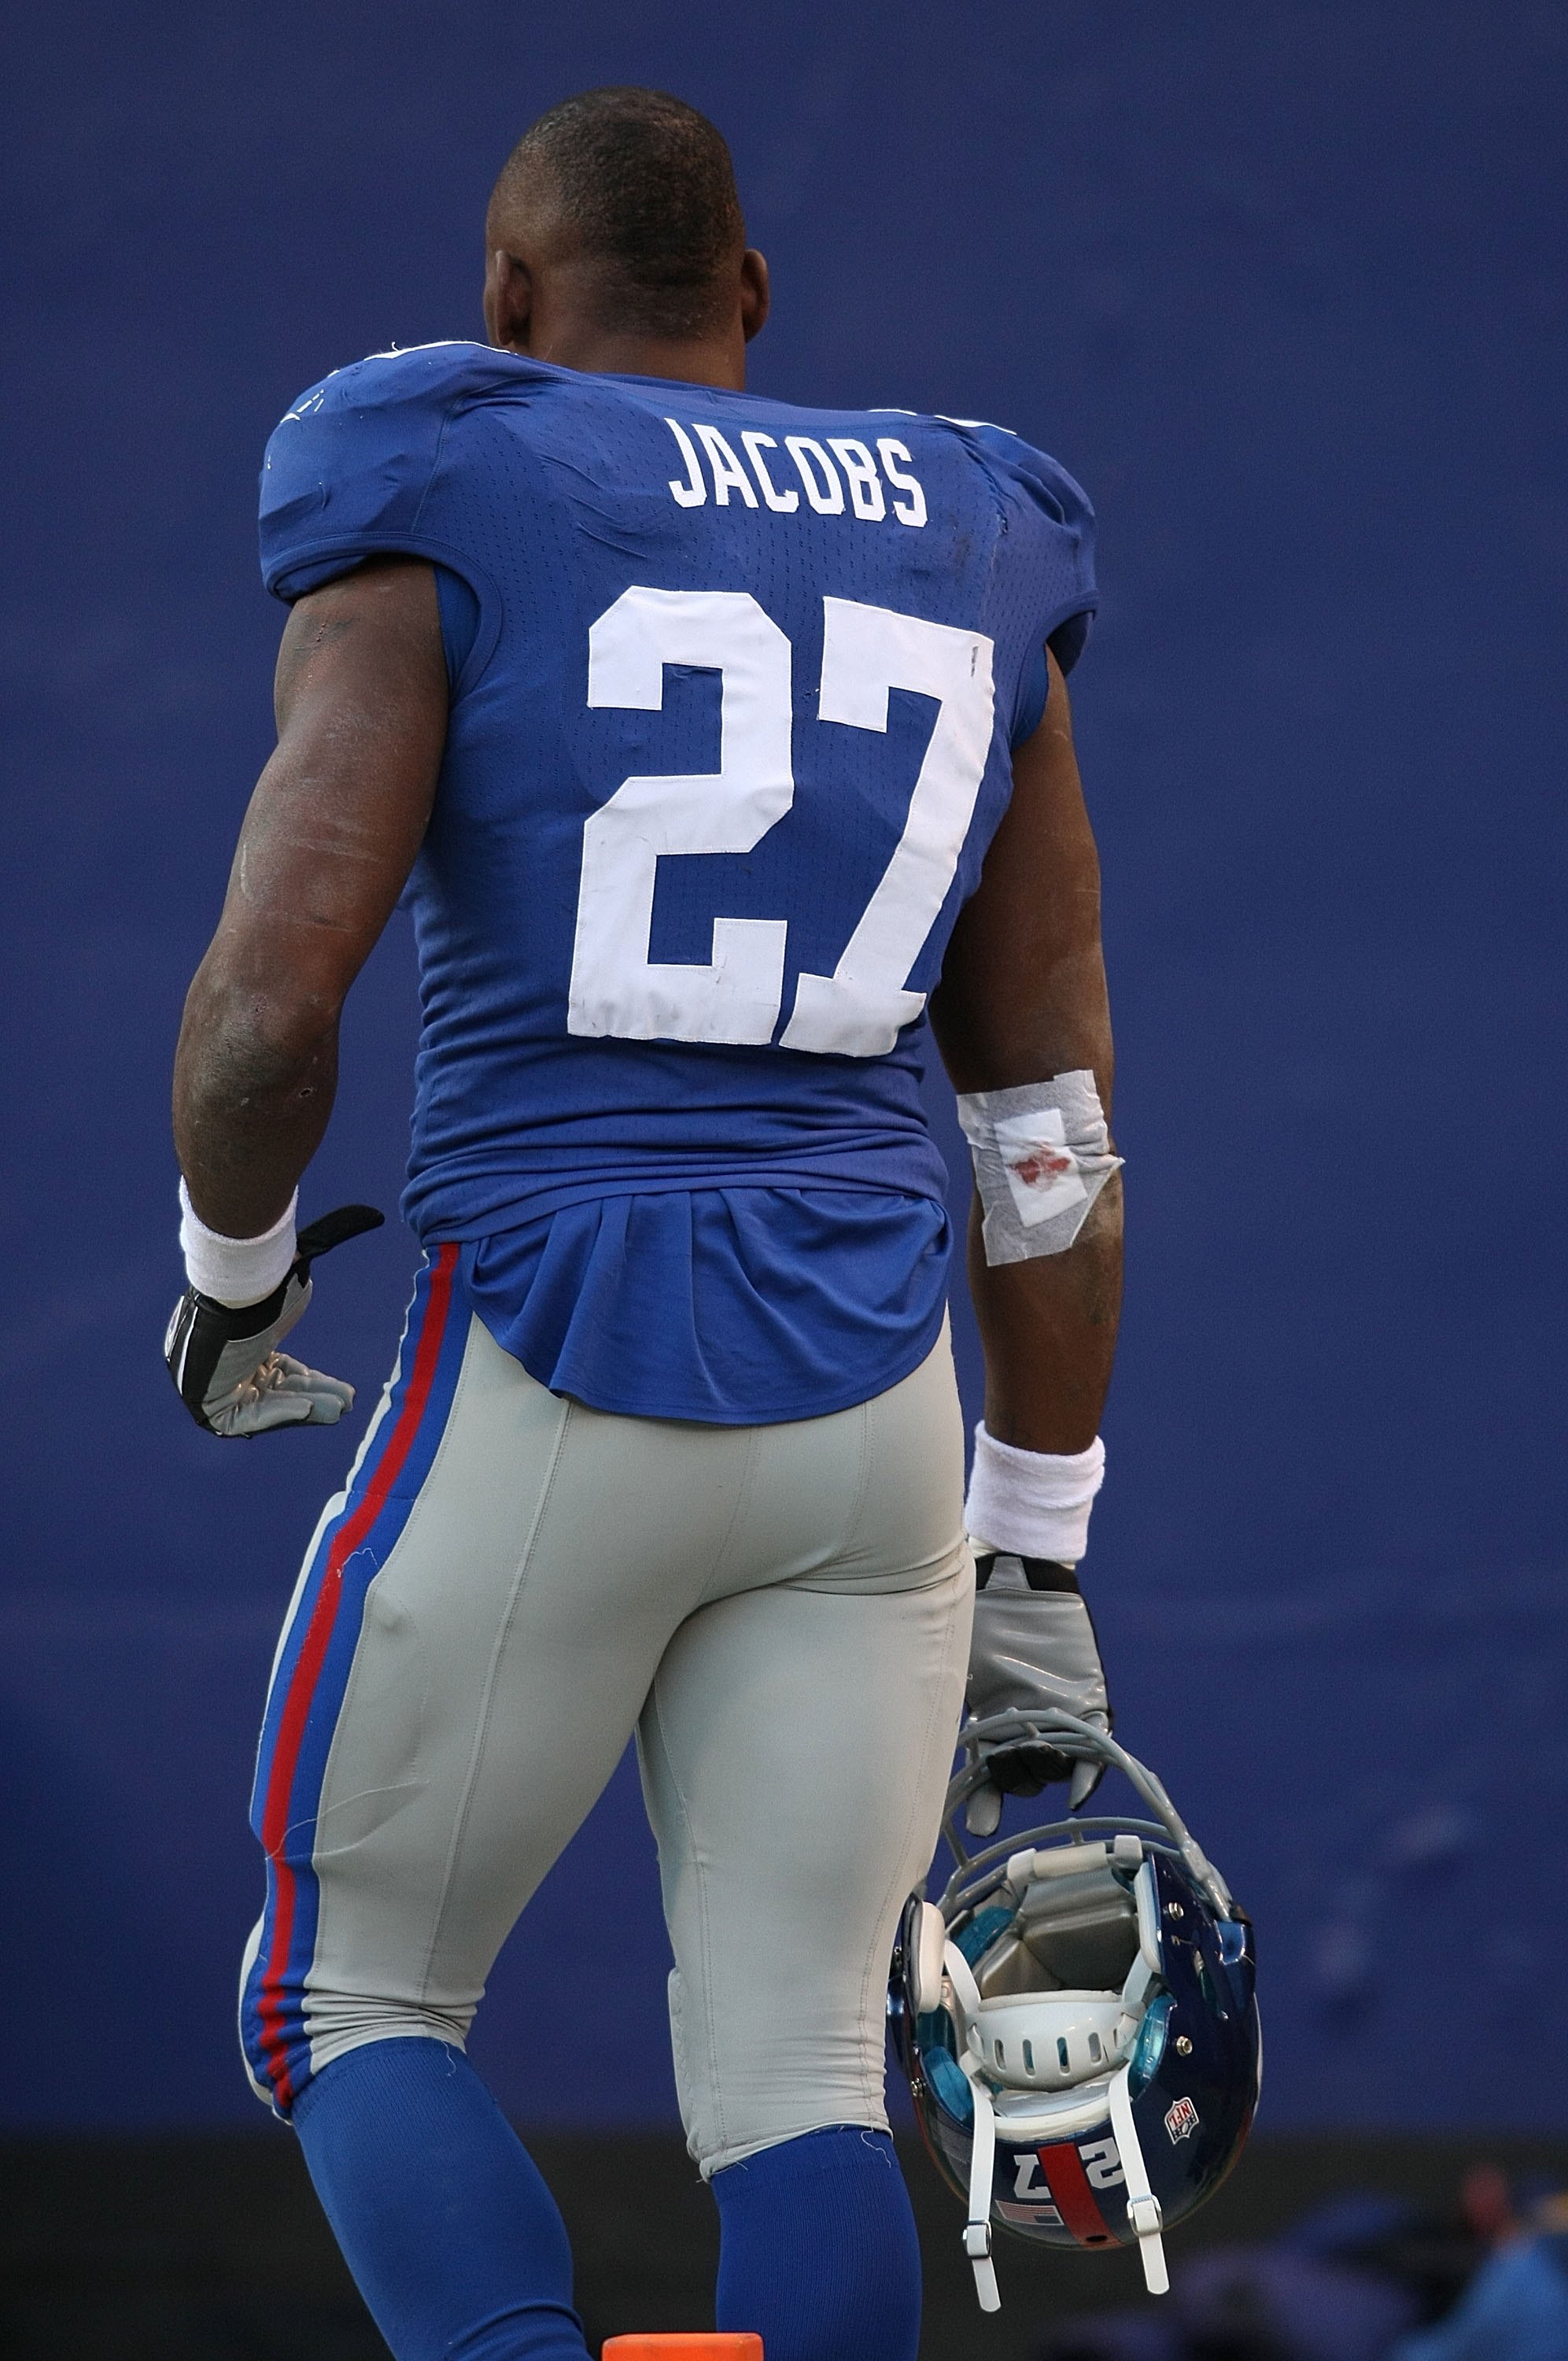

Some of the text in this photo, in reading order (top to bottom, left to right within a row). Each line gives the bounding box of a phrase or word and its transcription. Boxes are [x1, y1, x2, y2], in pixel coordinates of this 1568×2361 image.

[664, 417, 928, 527] JACOBS
[567, 586, 994, 1057] 27
[1169, 2102, 1192, 2126] NFL
